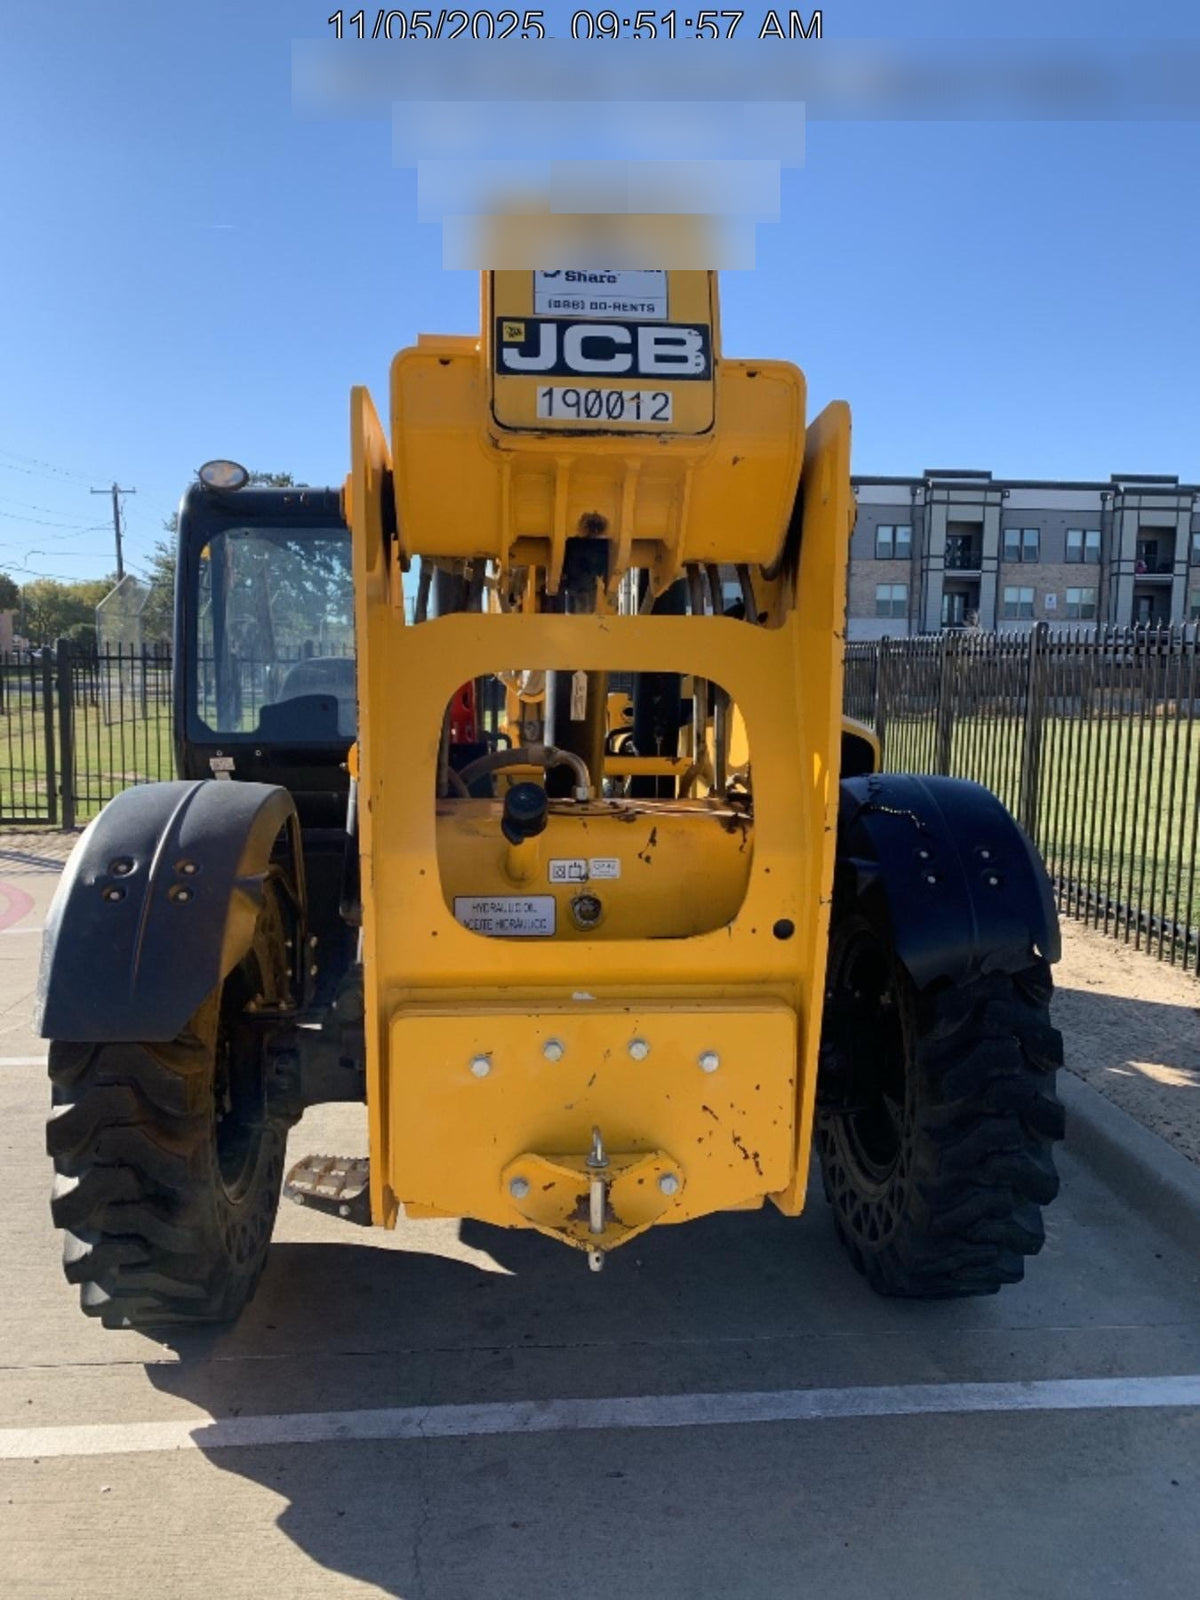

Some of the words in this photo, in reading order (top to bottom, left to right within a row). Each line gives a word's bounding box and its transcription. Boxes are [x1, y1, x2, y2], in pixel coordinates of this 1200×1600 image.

[564, 270, 618, 284] Share
[502, 322, 706, 375] JCB
[541, 387, 669, 421] 190012
